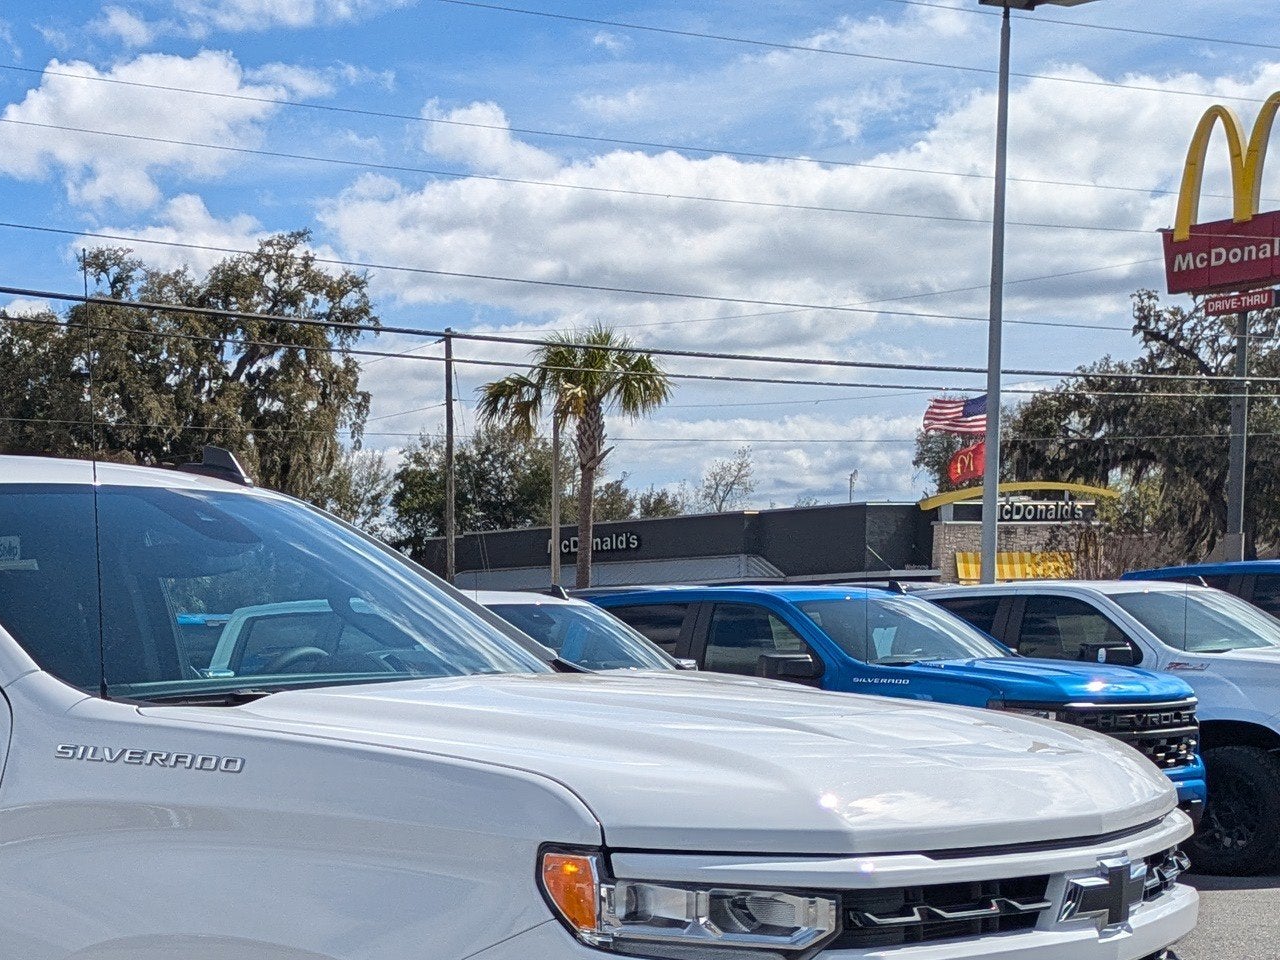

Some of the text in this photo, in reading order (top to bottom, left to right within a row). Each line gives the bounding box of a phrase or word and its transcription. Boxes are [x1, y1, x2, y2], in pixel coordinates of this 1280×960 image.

[1208, 293, 1268, 313] DRIVE-THRU
[996, 502, 1084, 520] cDonald's
[547, 532, 639, 554] cDnald's
[852, 677, 910, 685] SILVERADO
[55, 743, 246, 774] SILVERADO
